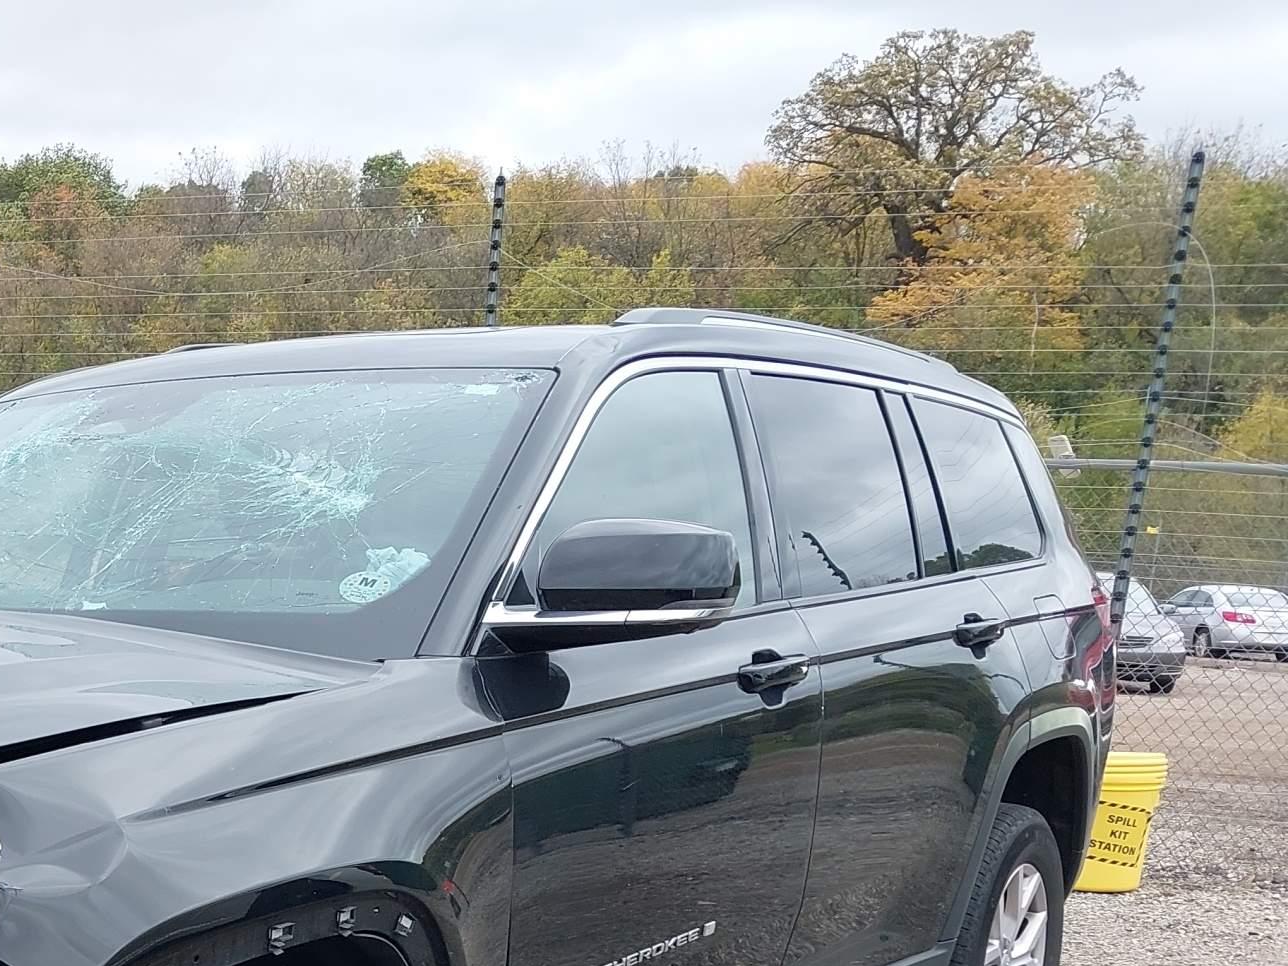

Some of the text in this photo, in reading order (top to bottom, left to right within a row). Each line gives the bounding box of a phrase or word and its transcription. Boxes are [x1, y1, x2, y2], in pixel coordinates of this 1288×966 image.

[358, 576, 378, 588] M
[1107, 814, 1137, 828] SPILL
[1109, 829, 1129, 840] KIT
[1088, 839, 1136, 855] STATION
